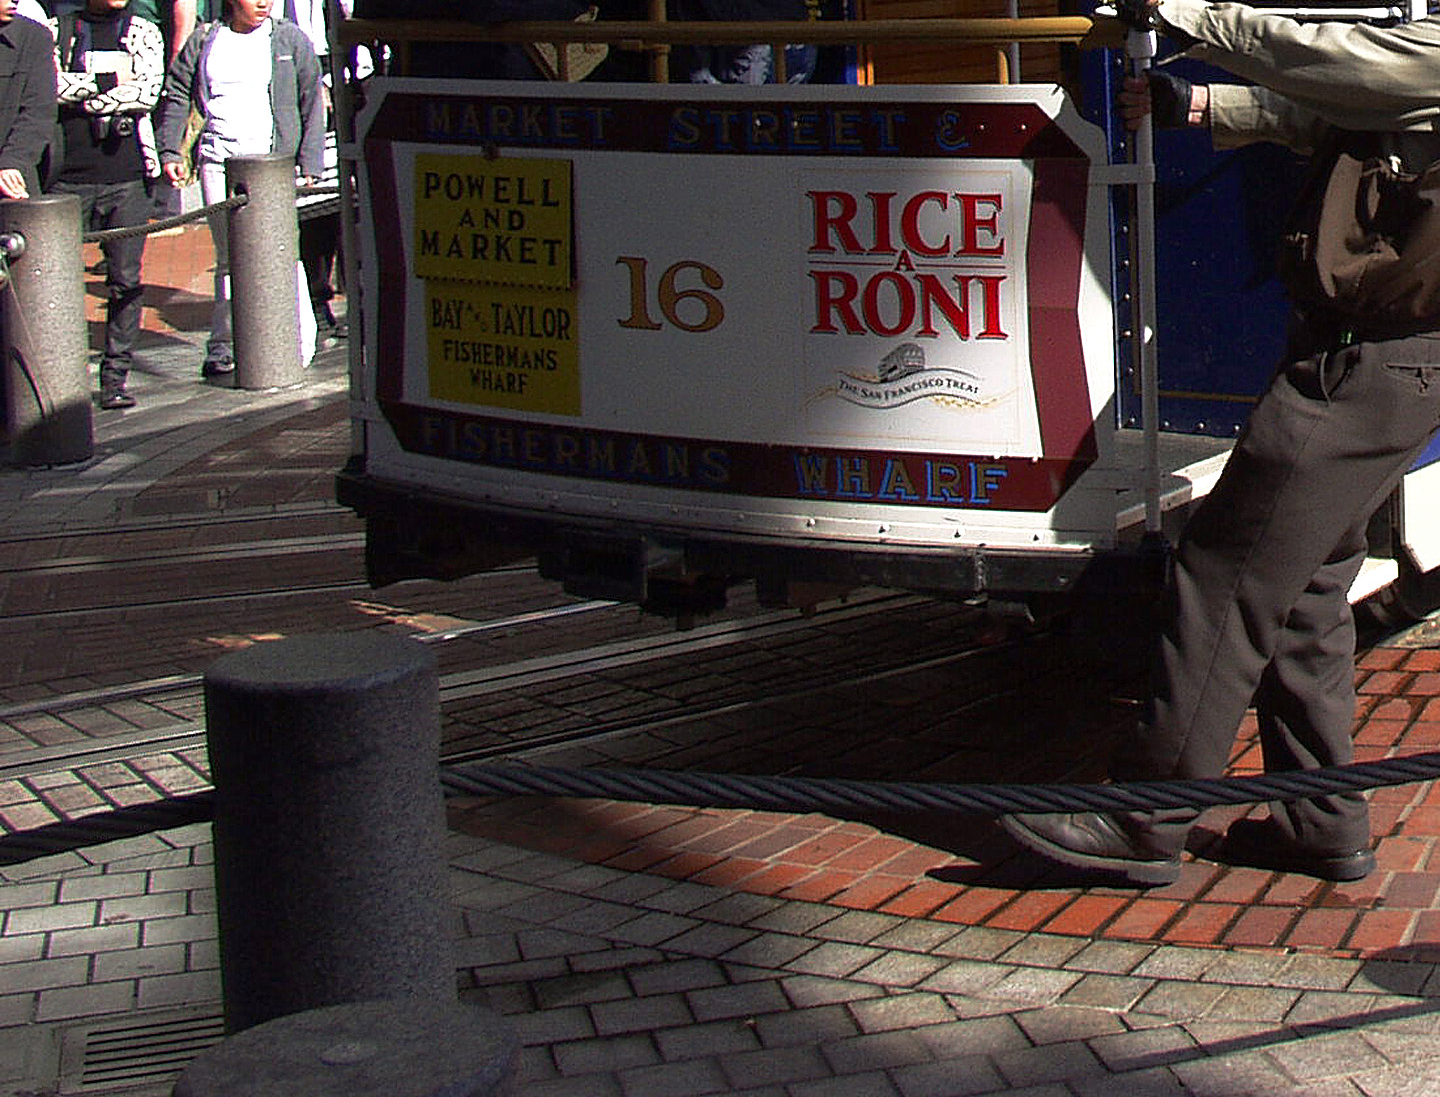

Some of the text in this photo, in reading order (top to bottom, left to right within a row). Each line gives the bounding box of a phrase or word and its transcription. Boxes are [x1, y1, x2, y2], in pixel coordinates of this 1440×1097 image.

[424, 101, 973, 151] MARKET STREET &
[424, 172, 560, 207] POWELL
[459, 208, 526, 232] AND
[805, 190, 1006, 258] RICE
[420, 229, 562, 267] MARKET
[894, 249, 916, 272] A
[615, 256, 724, 332] 16
[806, 270, 1010, 341] RONI
[431, 298, 463, 332] BAY
[491, 302, 571, 340] TAYLOR
[443, 339, 559, 371] FISHERMANS
[470, 368, 529, 395] WHARF
[884, 378, 944, 401] FRANCISCO
[416, 416, 1008, 504] FISHERMANS WHARF
